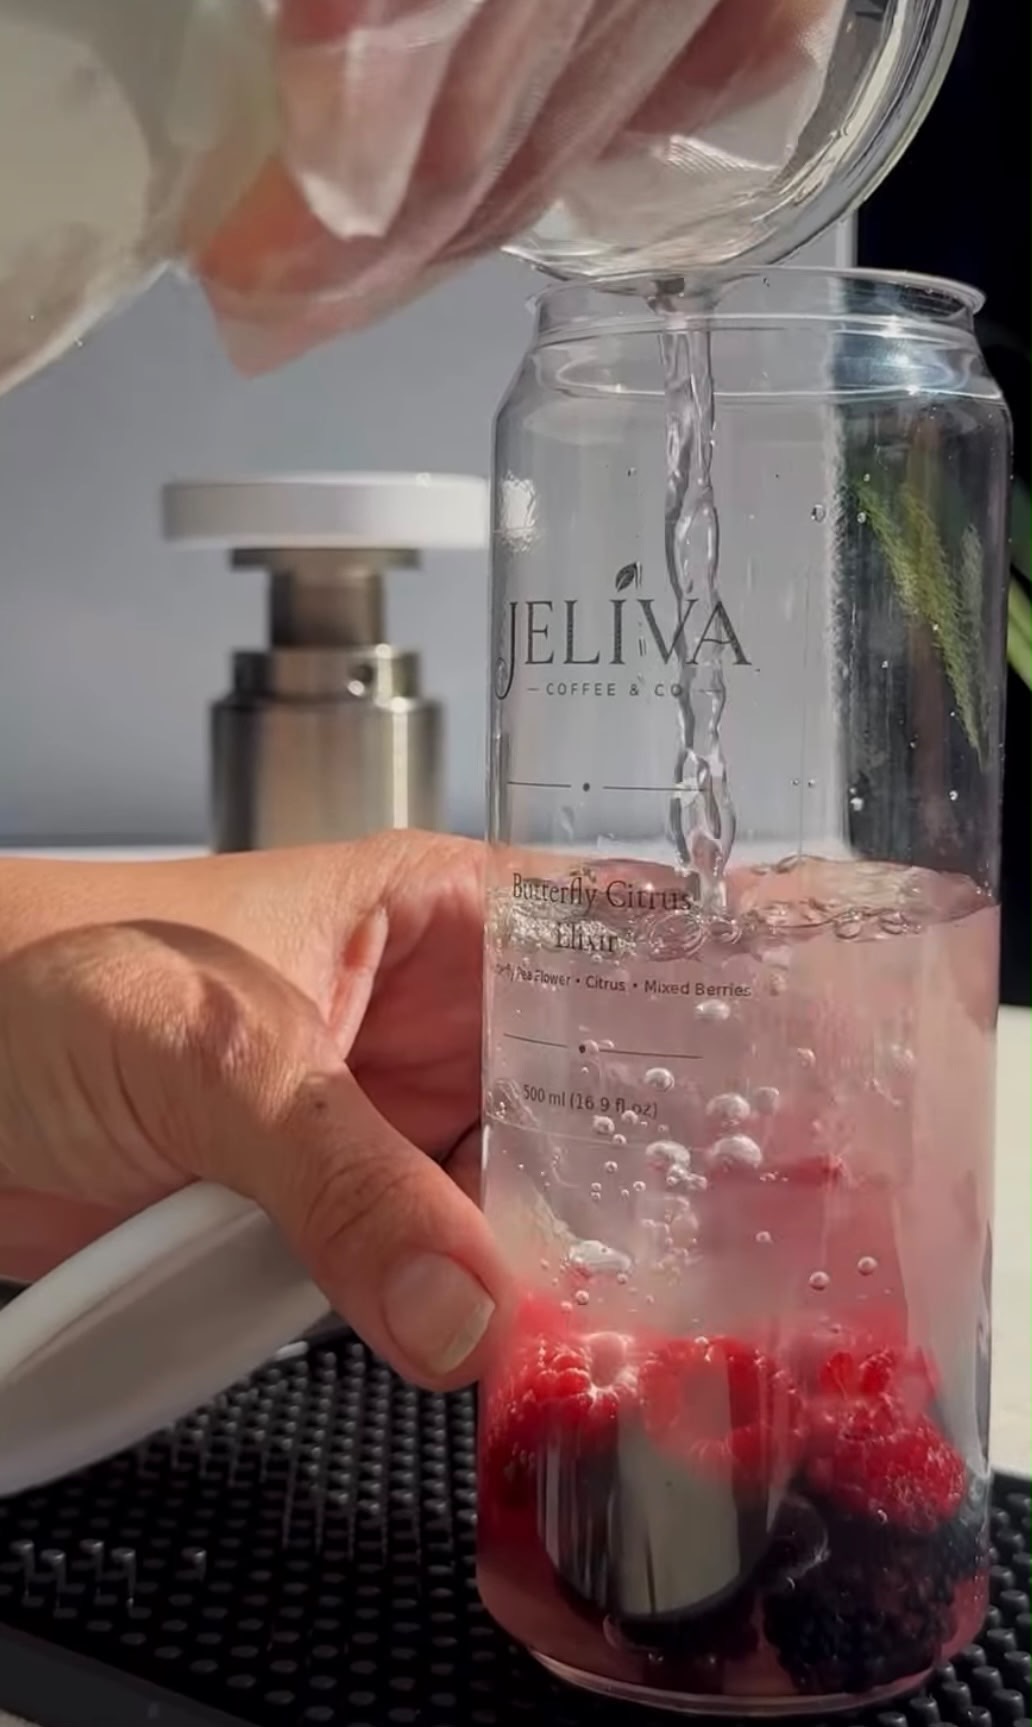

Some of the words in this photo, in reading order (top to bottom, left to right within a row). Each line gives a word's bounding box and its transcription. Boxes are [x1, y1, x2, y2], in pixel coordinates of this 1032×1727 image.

[545, 682, 617, 697] COFFEE
[628, 682, 641, 697] &
[512, 872, 598, 918] Butterfly
[605, 879, 693, 911] Citrus
[555, 921, 619, 953] Elixir
[585, 974, 626, 992] Citrus
[643, 979, 690, 996] Mixed
[694, 981, 752, 997] Berries
[523, 1083, 546, 1103] 500
[548, 1091, 566, 1107] ml
[631, 1101, 658, 1120] oz)
